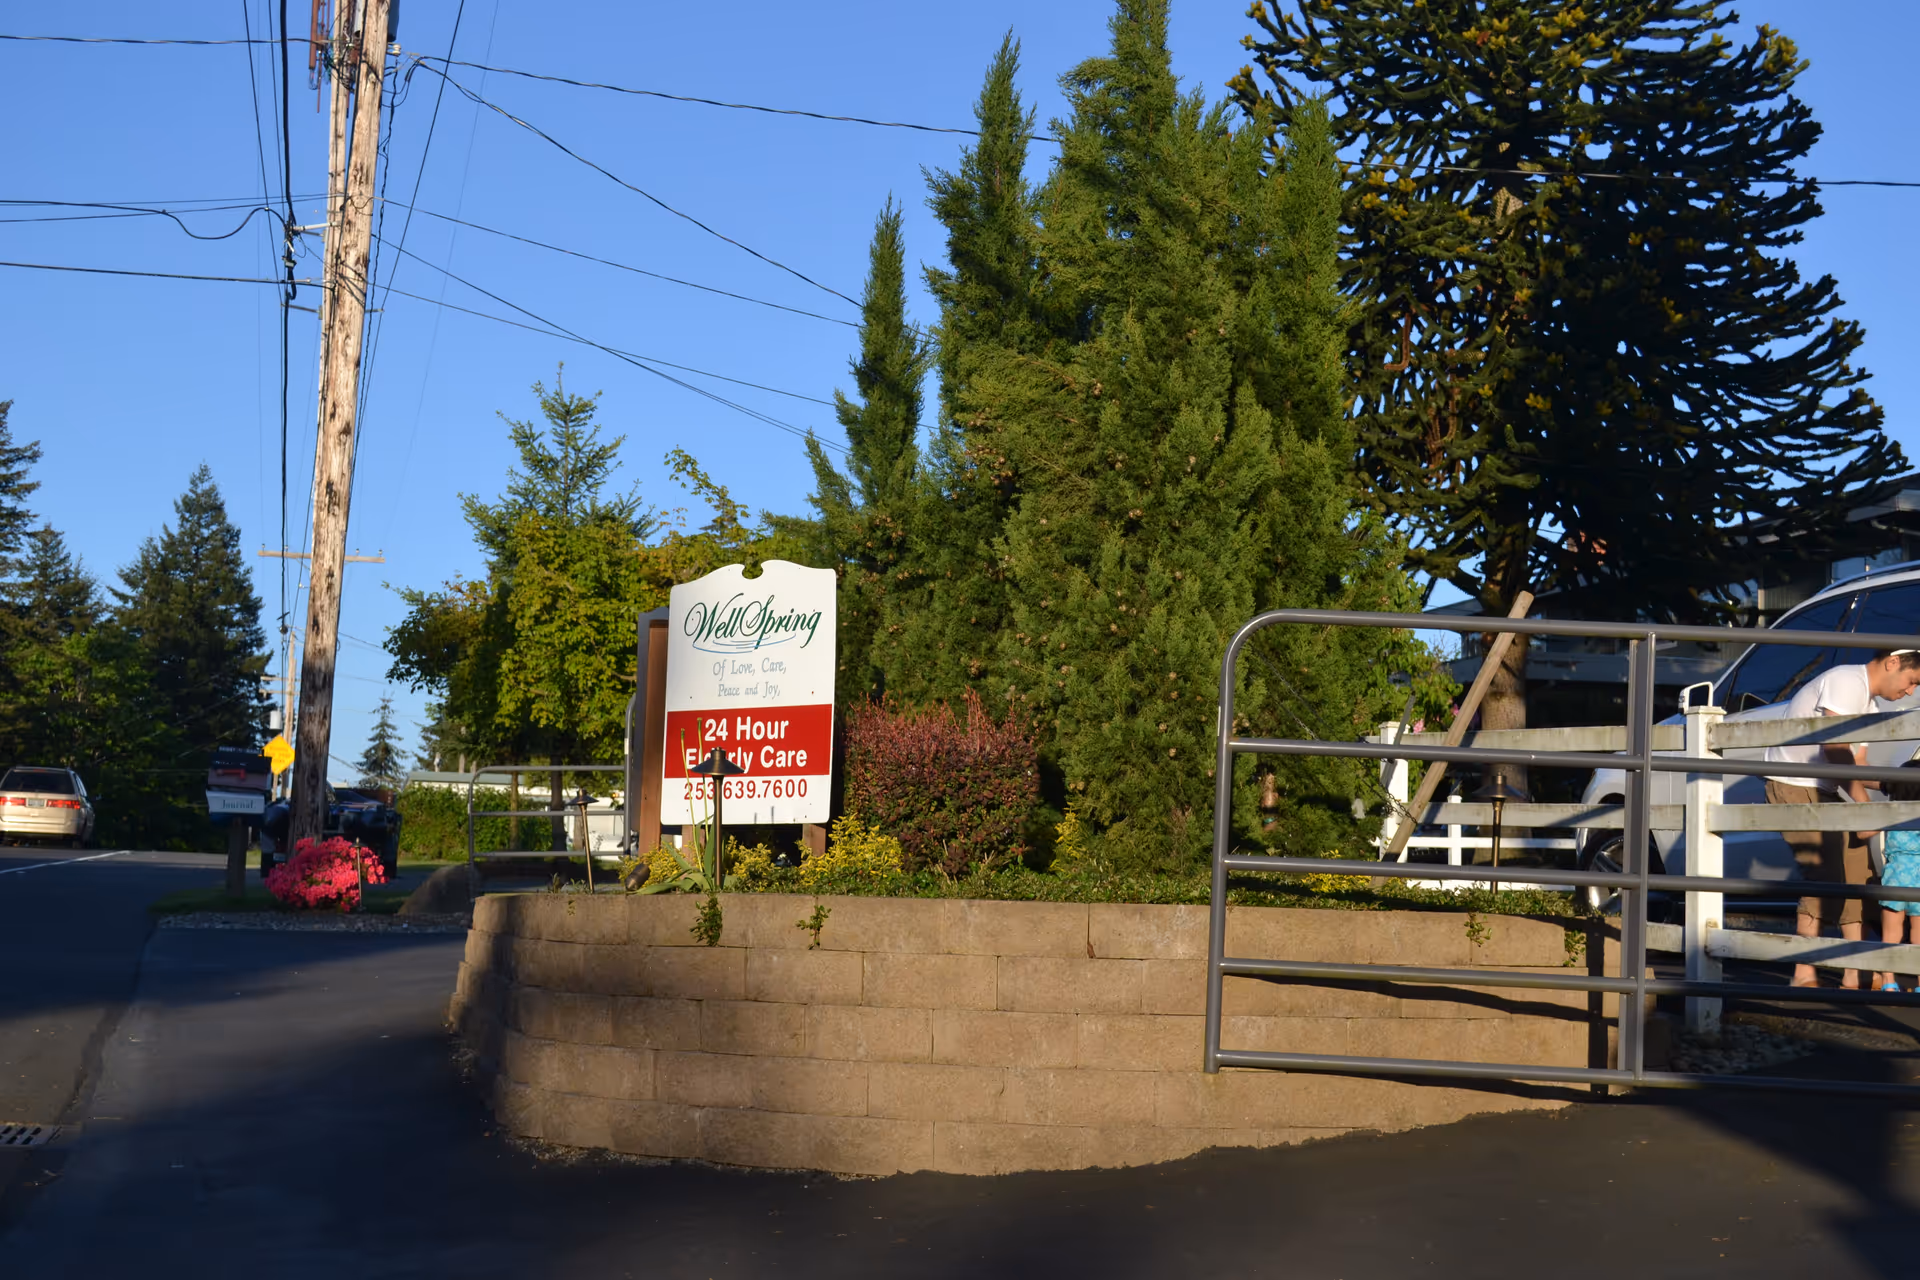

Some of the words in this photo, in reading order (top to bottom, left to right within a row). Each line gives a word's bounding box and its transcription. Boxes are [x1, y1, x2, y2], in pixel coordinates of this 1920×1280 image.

[712, 659, 727, 681] Of
[730, 659, 756, 676] Love,
[761, 657, 787, 677] Care,
[718, 683, 740, 697] Peace
[744, 682, 759, 696] and
[763, 681, 781, 700] Joy,
[704, 718, 728, 742] 24
[736, 715, 789, 741] Hour
[686, 746, 754, 774] Elrly
[760, 745, 808, 769] Care
[683, 778, 808, 801] 253639.7600
